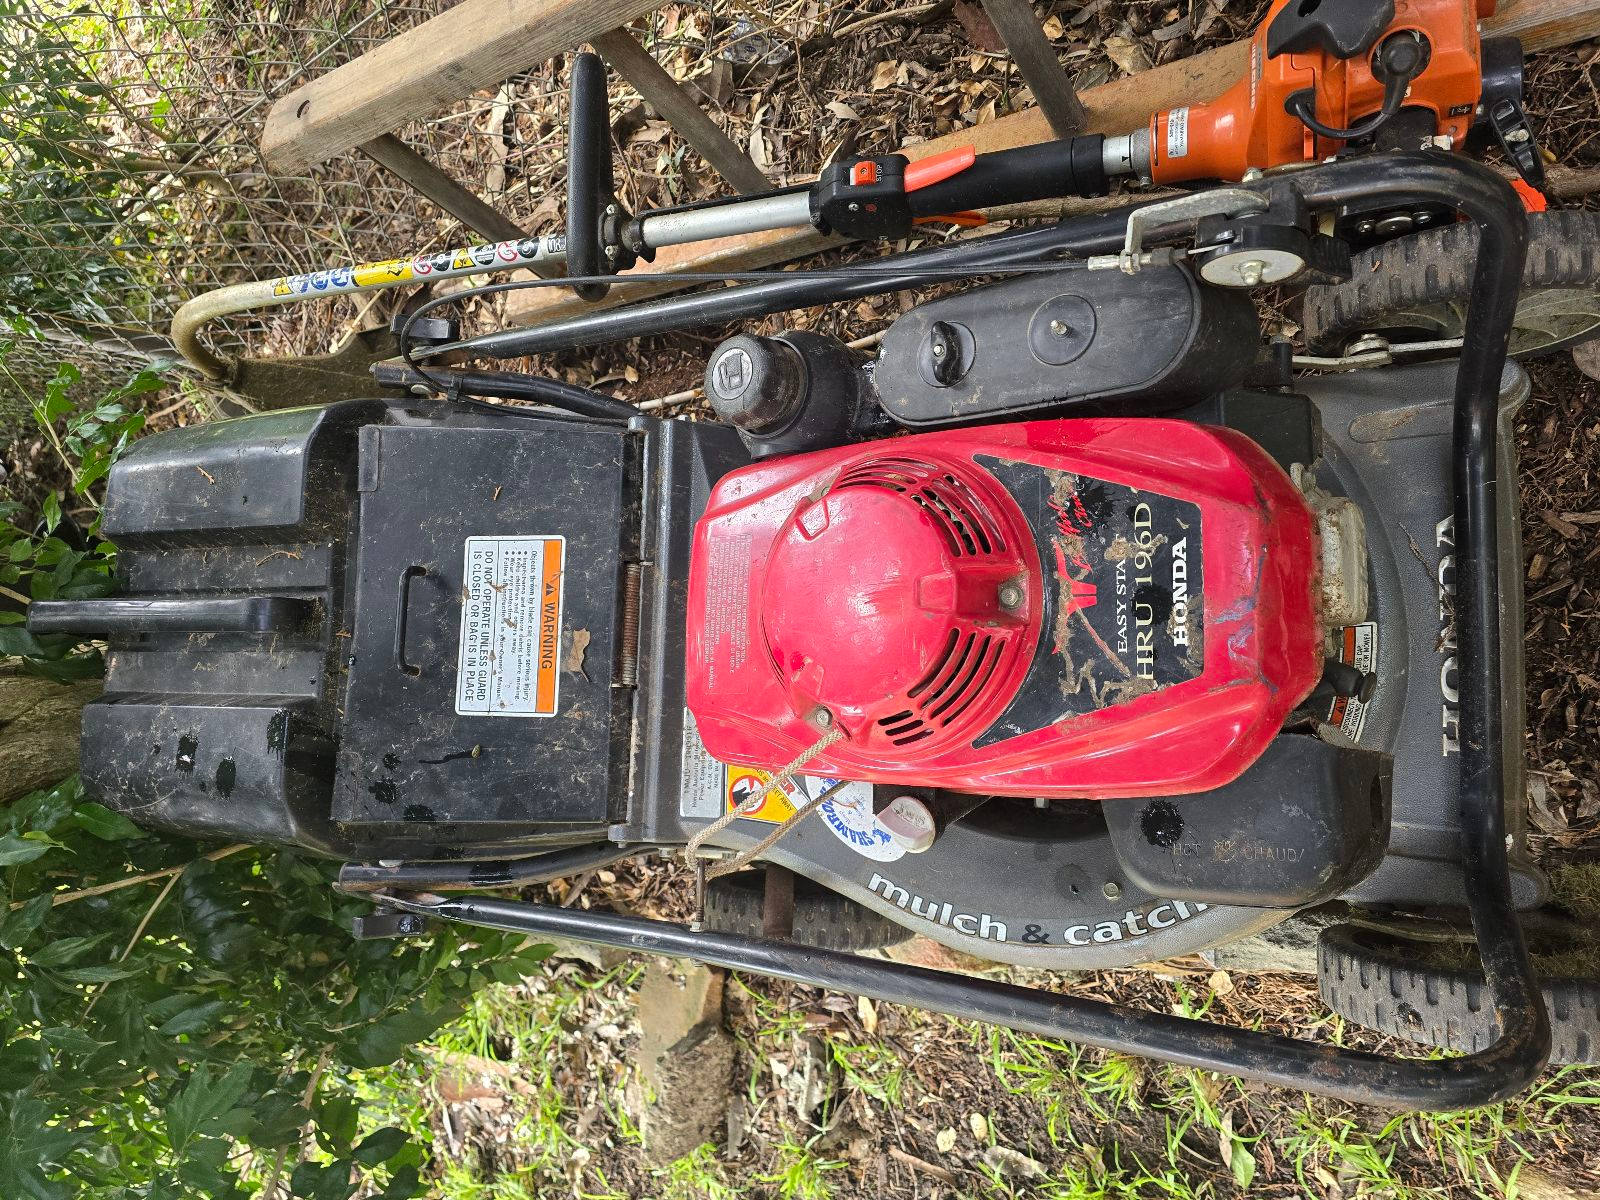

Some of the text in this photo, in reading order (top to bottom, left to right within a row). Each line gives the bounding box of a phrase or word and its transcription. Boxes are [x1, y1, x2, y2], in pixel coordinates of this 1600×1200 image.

[465, 551, 482, 702] IS CLOSED OR BAG IS IN PLACE
[477, 551, 493, 701] DO NOT OPERATE UNLESS GUARD
[542, 603, 555, 669] WARNING
[1115, 533, 1127, 653] EASY STA
[1134, 502, 1154, 680] HRU 196D
[1172, 537, 1188, 647] HONDA
[779, 796, 792, 811] AWAY
[1172, 843, 1200, 857] HOT
[867, 872, 1209, 946] mulch & catch
